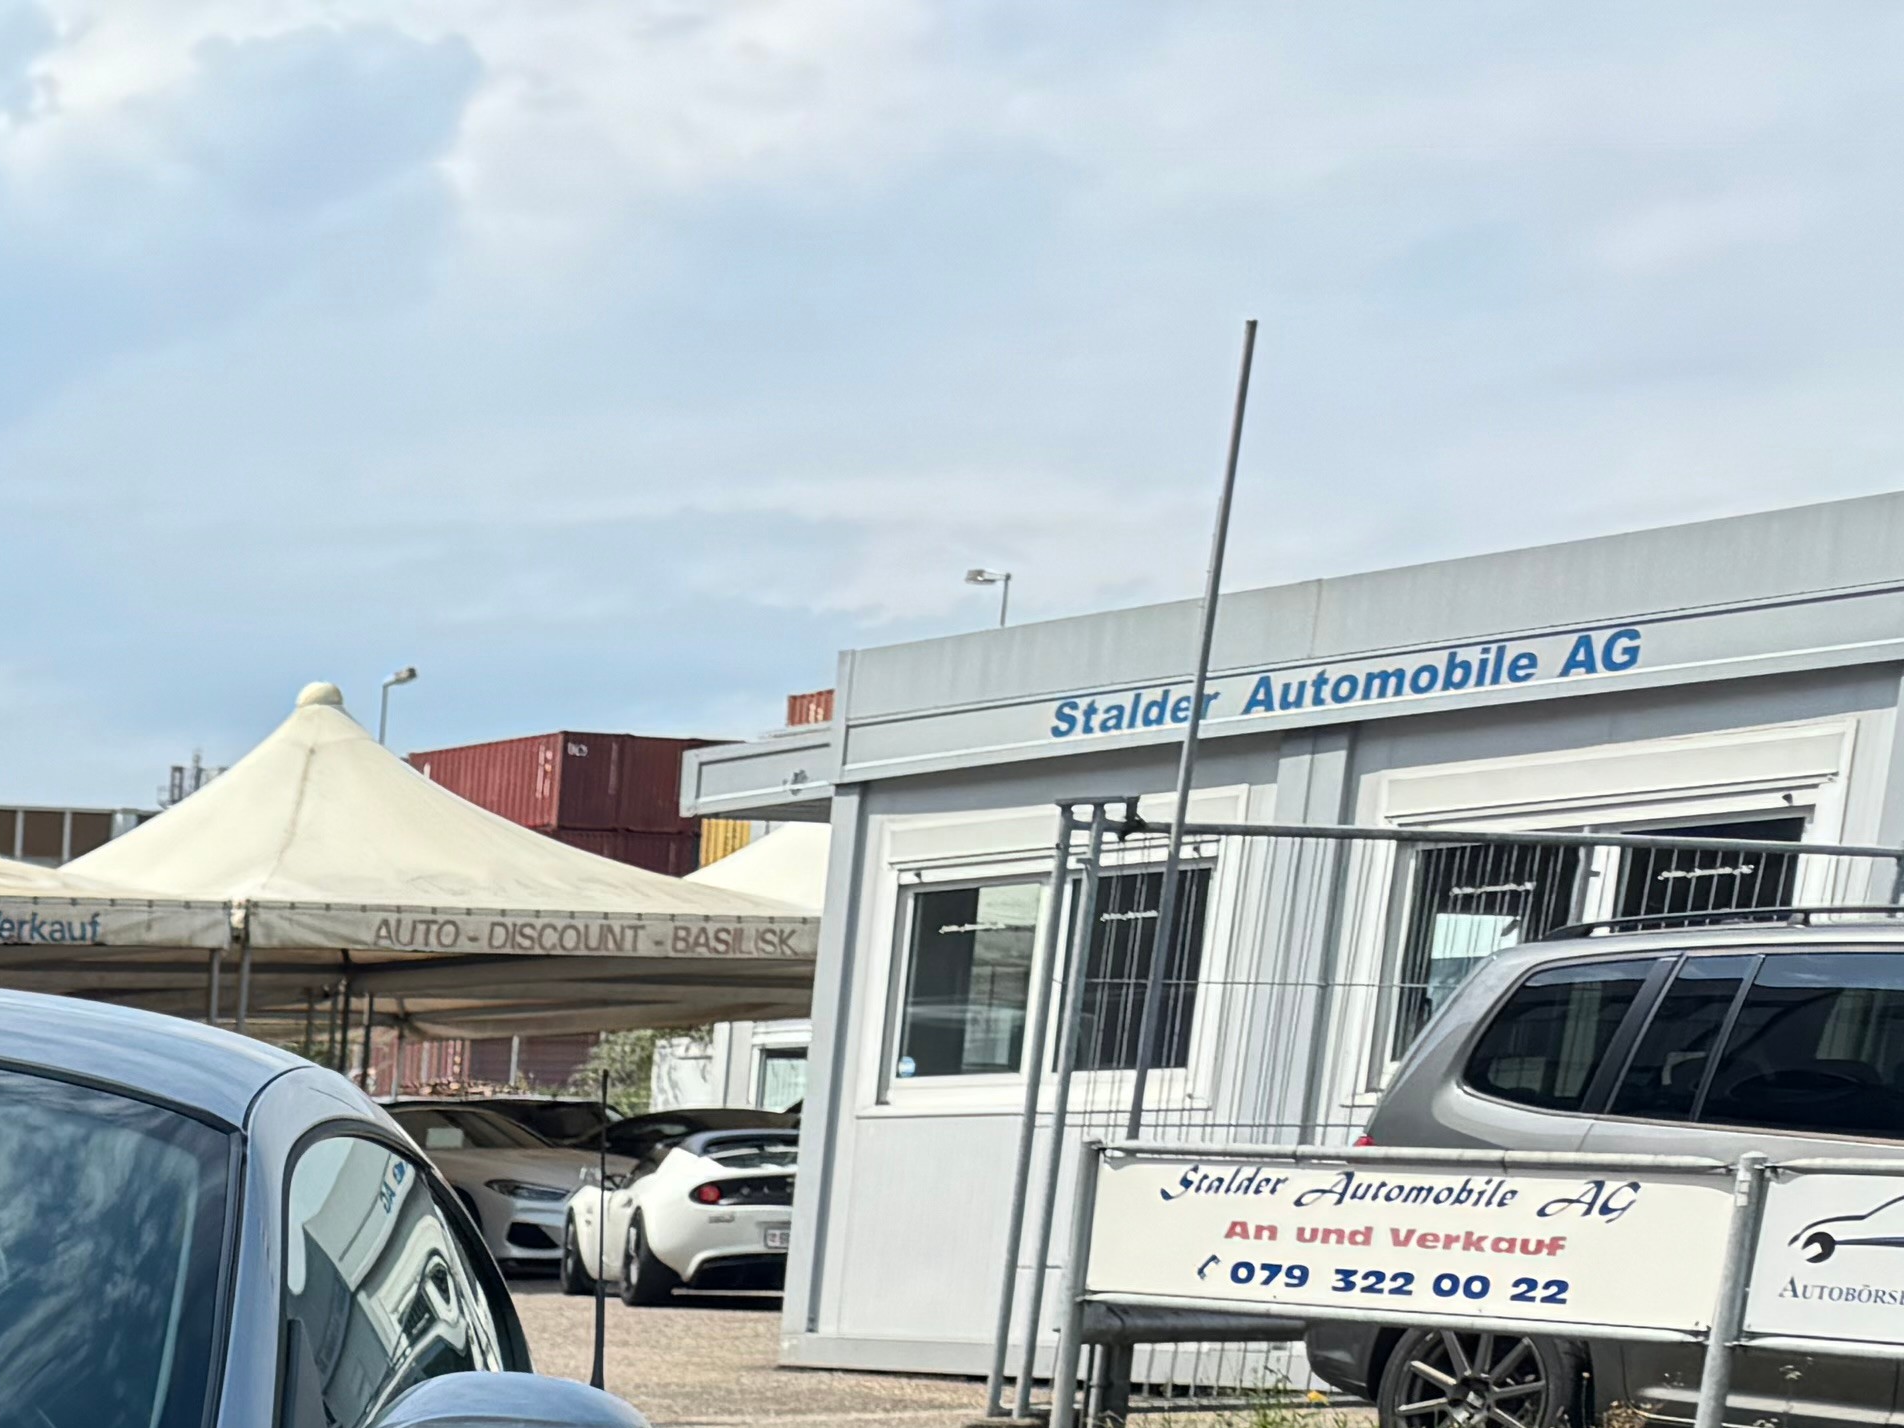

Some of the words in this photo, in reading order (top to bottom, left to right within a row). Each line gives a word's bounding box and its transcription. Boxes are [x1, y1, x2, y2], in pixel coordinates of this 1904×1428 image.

[1050, 688, 1221, 738] Stalder
[1242, 645, 1539, 716] Automobile
[1558, 628, 1642, 678] AG
[373, 918, 461, 948] AUTO
[487, 921, 645, 953] DISCOUNT
[671, 926, 800, 957] BASILISK
[1159, 1164, 1290, 1201] Stalder
[1294, 1169, 1519, 1208] Automobile
[1536, 1179, 1643, 1224] AG
[1223, 1219, 1279, 1241] An
[1295, 1224, 1374, 1247] und
[1388, 1227, 1567, 1257] Verkauf
[1230, 1260, 1310, 1288] 079
[1331, 1268, 1415, 1296] 322
[1432, 1272, 1491, 1299] 00
[1509, 1277, 1570, 1305] 22
